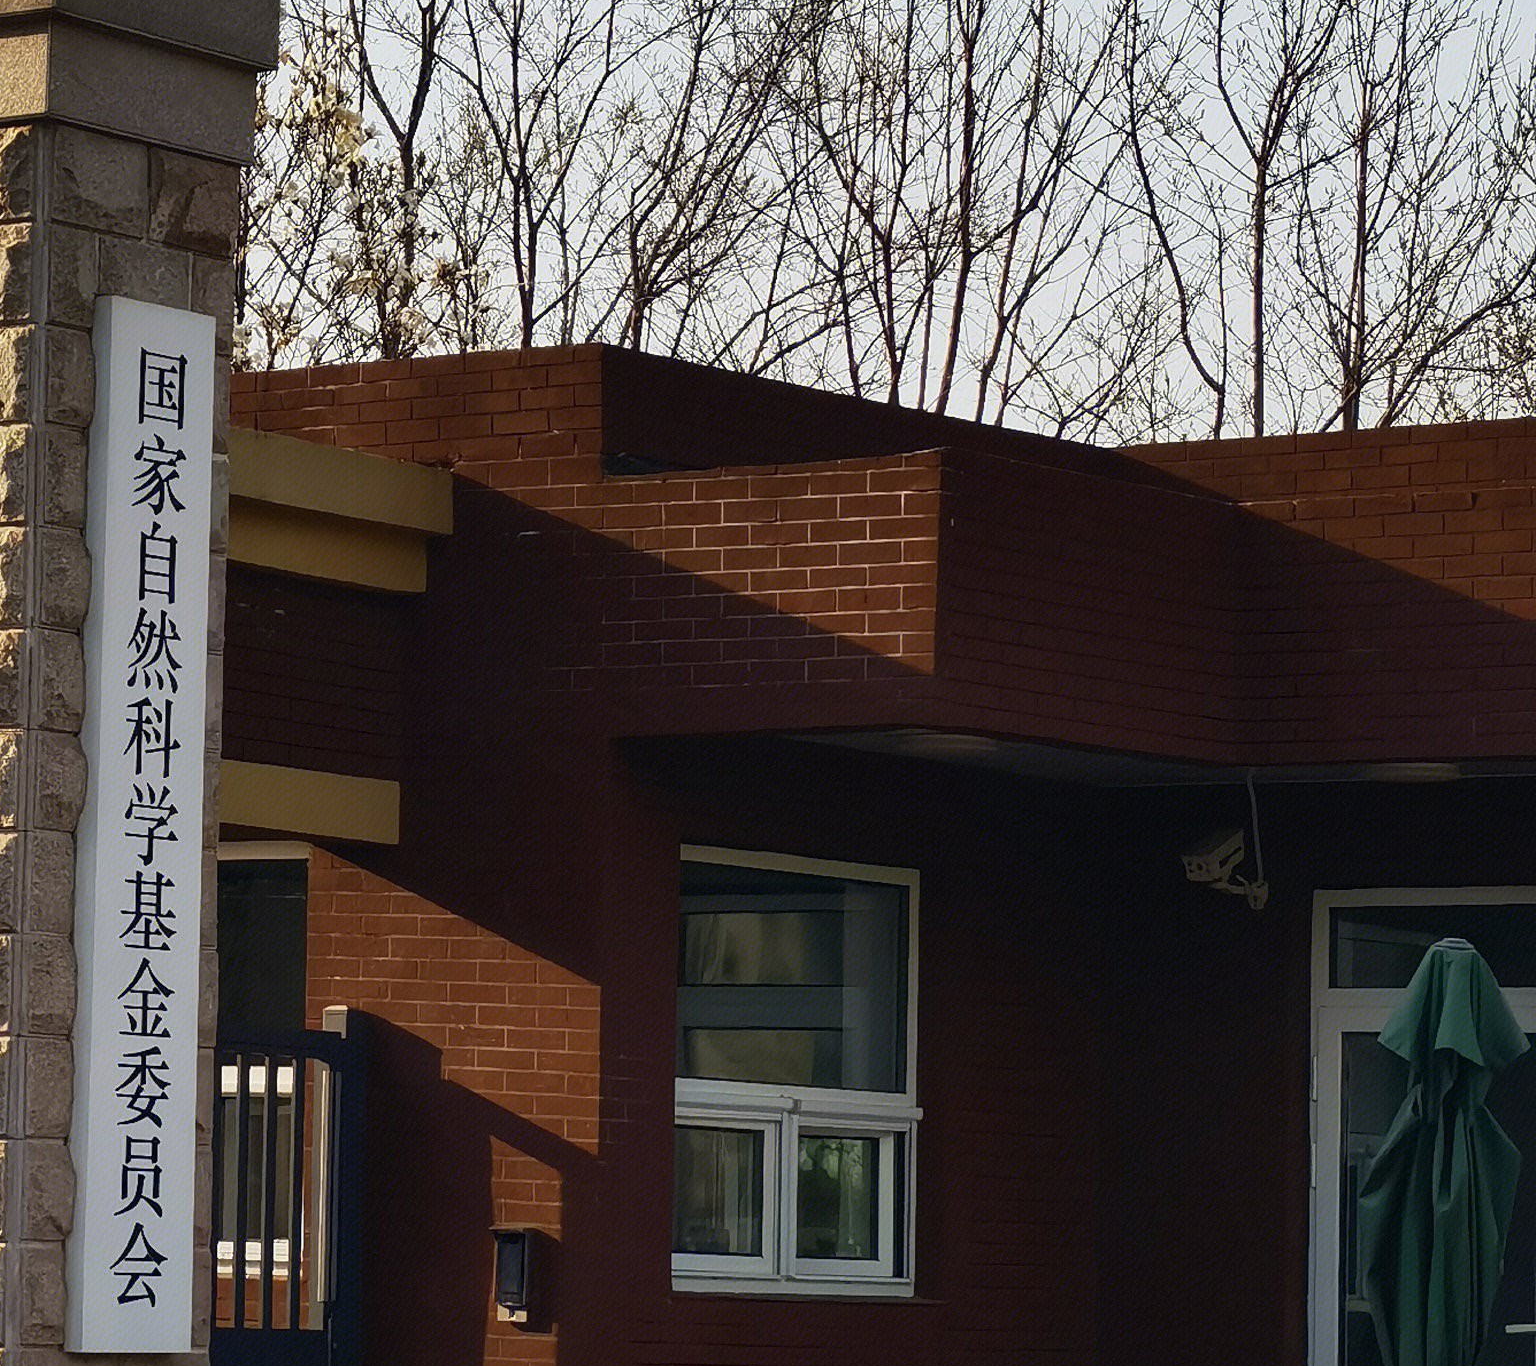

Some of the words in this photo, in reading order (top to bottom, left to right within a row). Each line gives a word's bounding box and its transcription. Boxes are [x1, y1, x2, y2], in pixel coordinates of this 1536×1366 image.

[110, 346, 188, 1308] 国家自然科学基金委员会
